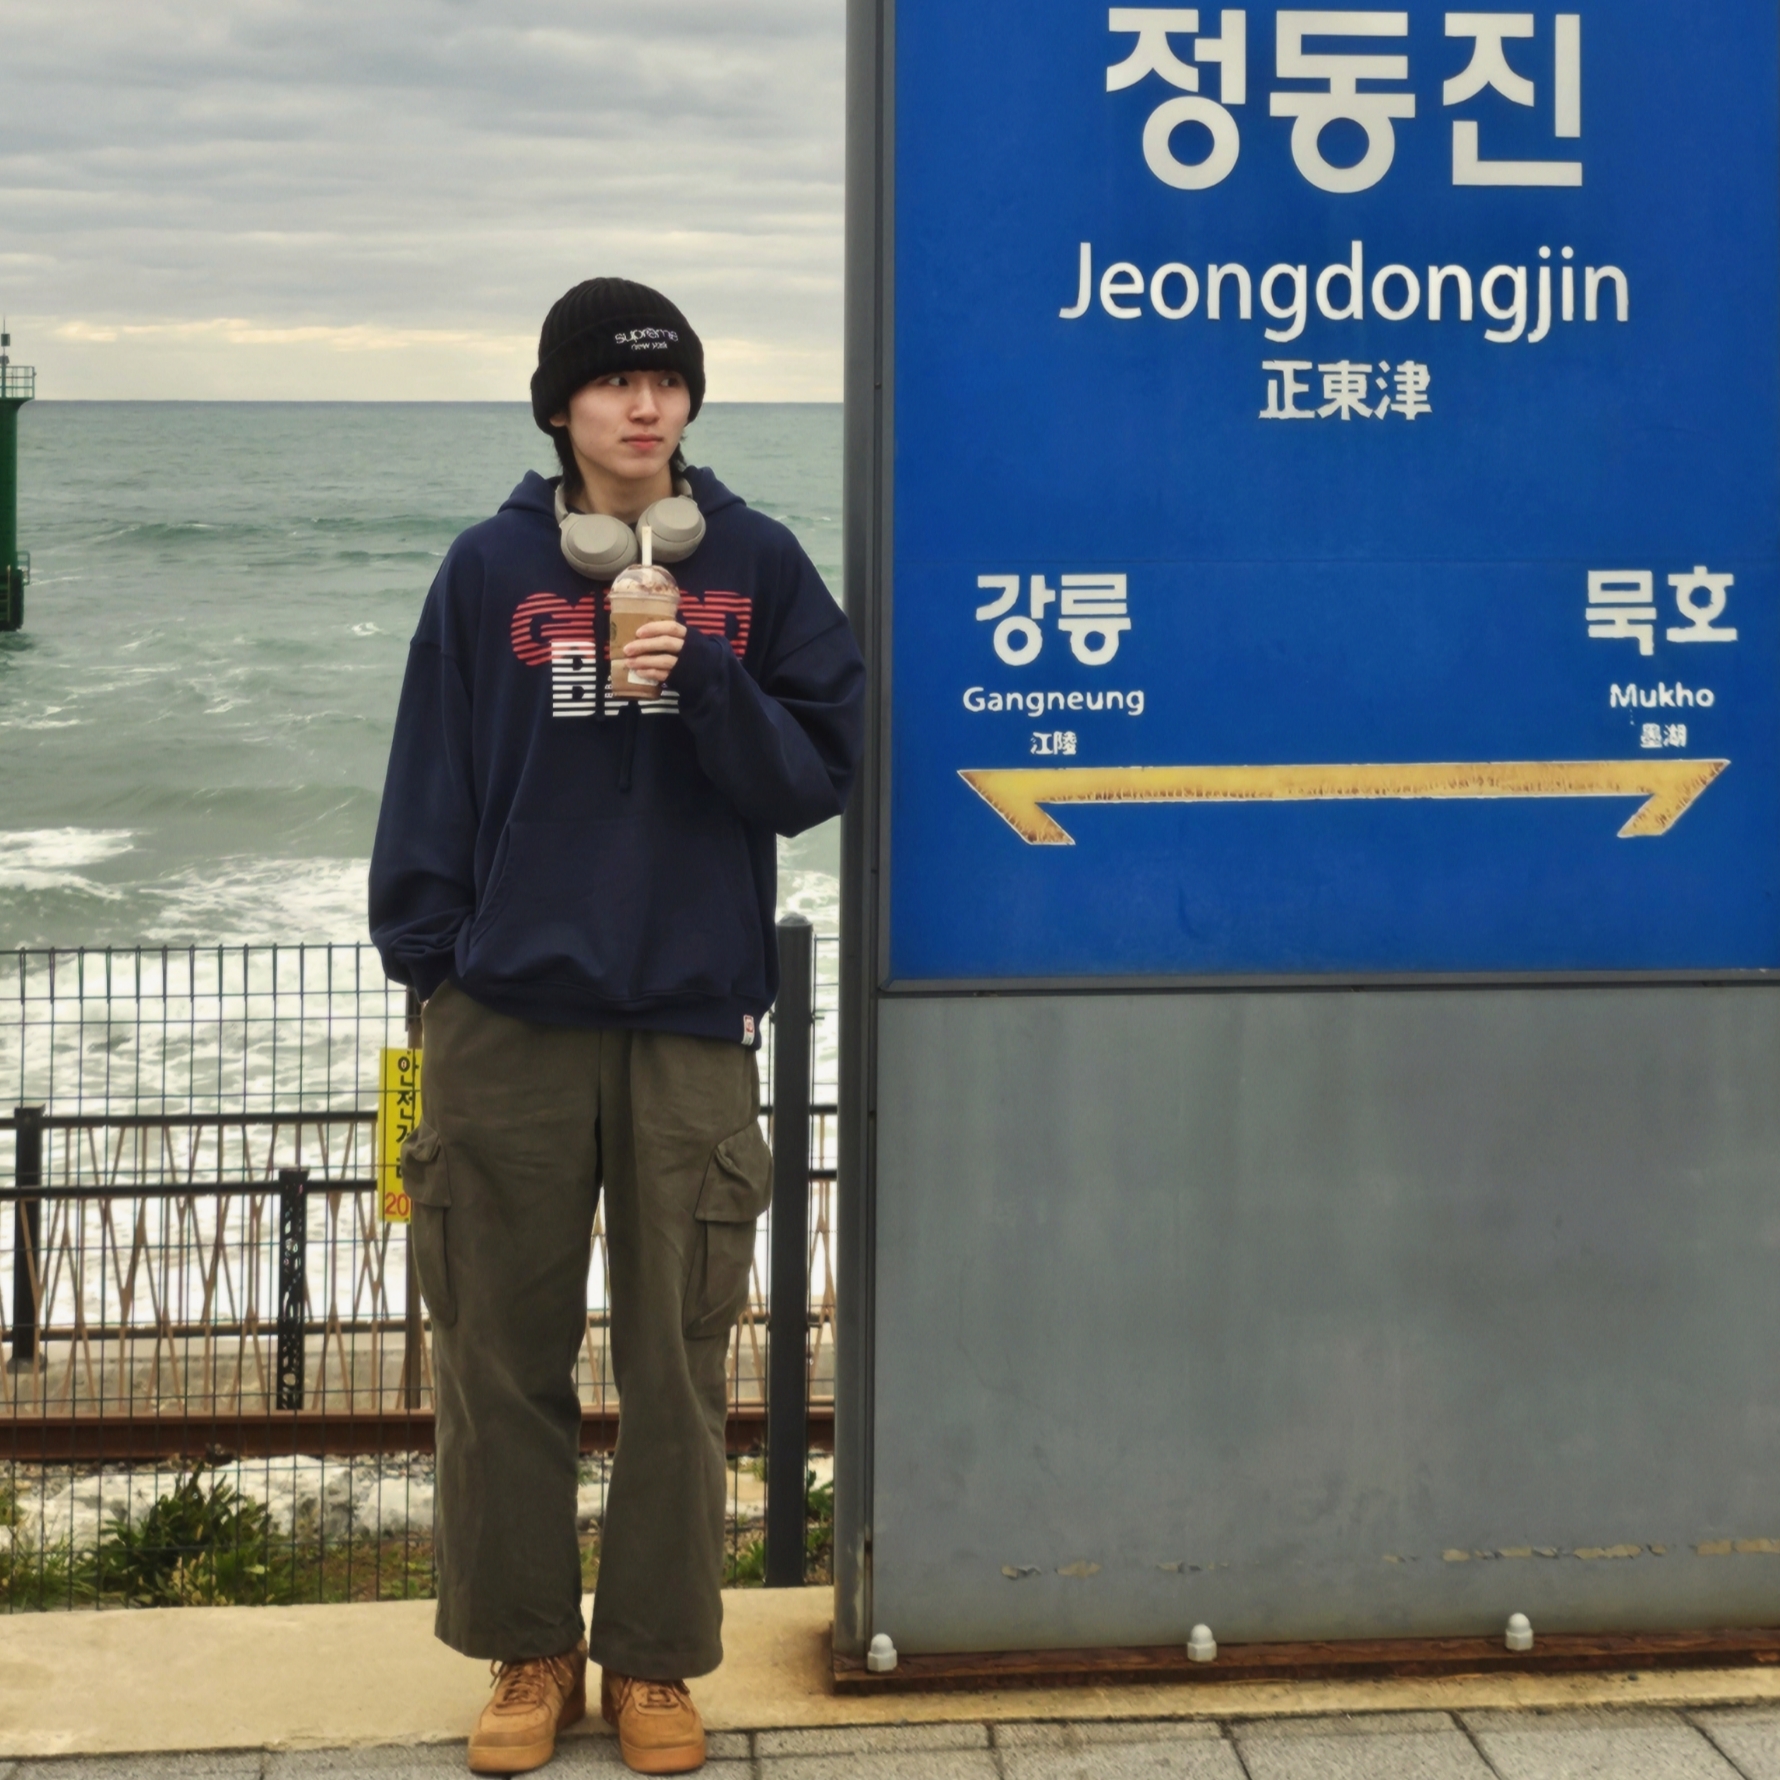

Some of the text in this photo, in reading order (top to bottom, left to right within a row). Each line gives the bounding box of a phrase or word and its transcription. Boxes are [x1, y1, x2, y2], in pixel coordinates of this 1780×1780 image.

[1106, 8, 1582, 193] 정동진
[1059, 241, 1628, 343] Jeongdongjin
[1259, 360, 1431, 420] 正東津
[976, 574, 1131, 666] 강릉
[1586, 566, 1737, 655] 묵호
[963, 687, 1144, 717] Gangneung
[1610, 682, 1714, 707] Mukho
[1031, 731, 1077, 755] 江陵
